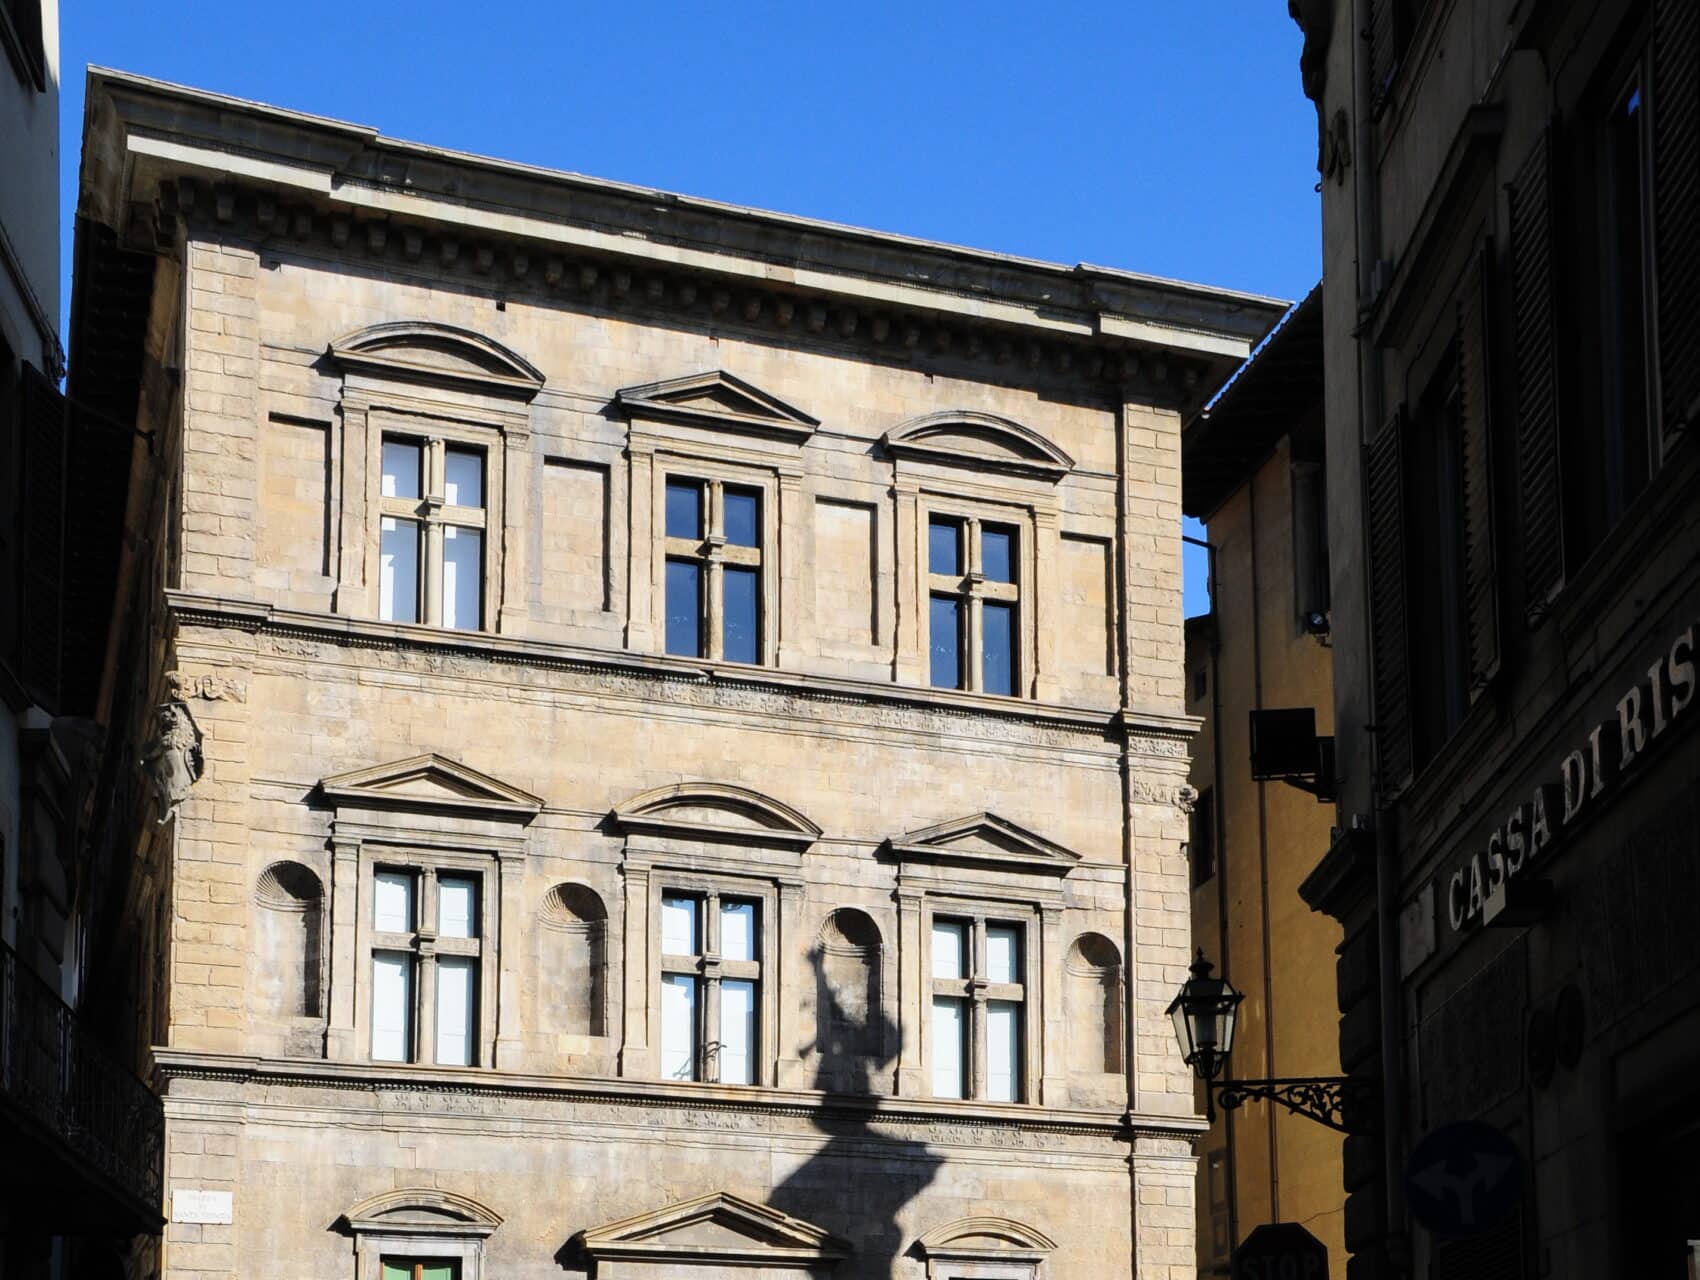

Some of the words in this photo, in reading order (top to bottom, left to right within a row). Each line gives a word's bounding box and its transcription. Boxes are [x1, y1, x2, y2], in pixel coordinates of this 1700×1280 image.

[1449, 785, 1551, 932] CASSA
[1560, 723, 1605, 827] DI
[1615, 625, 1696, 771] RIS
